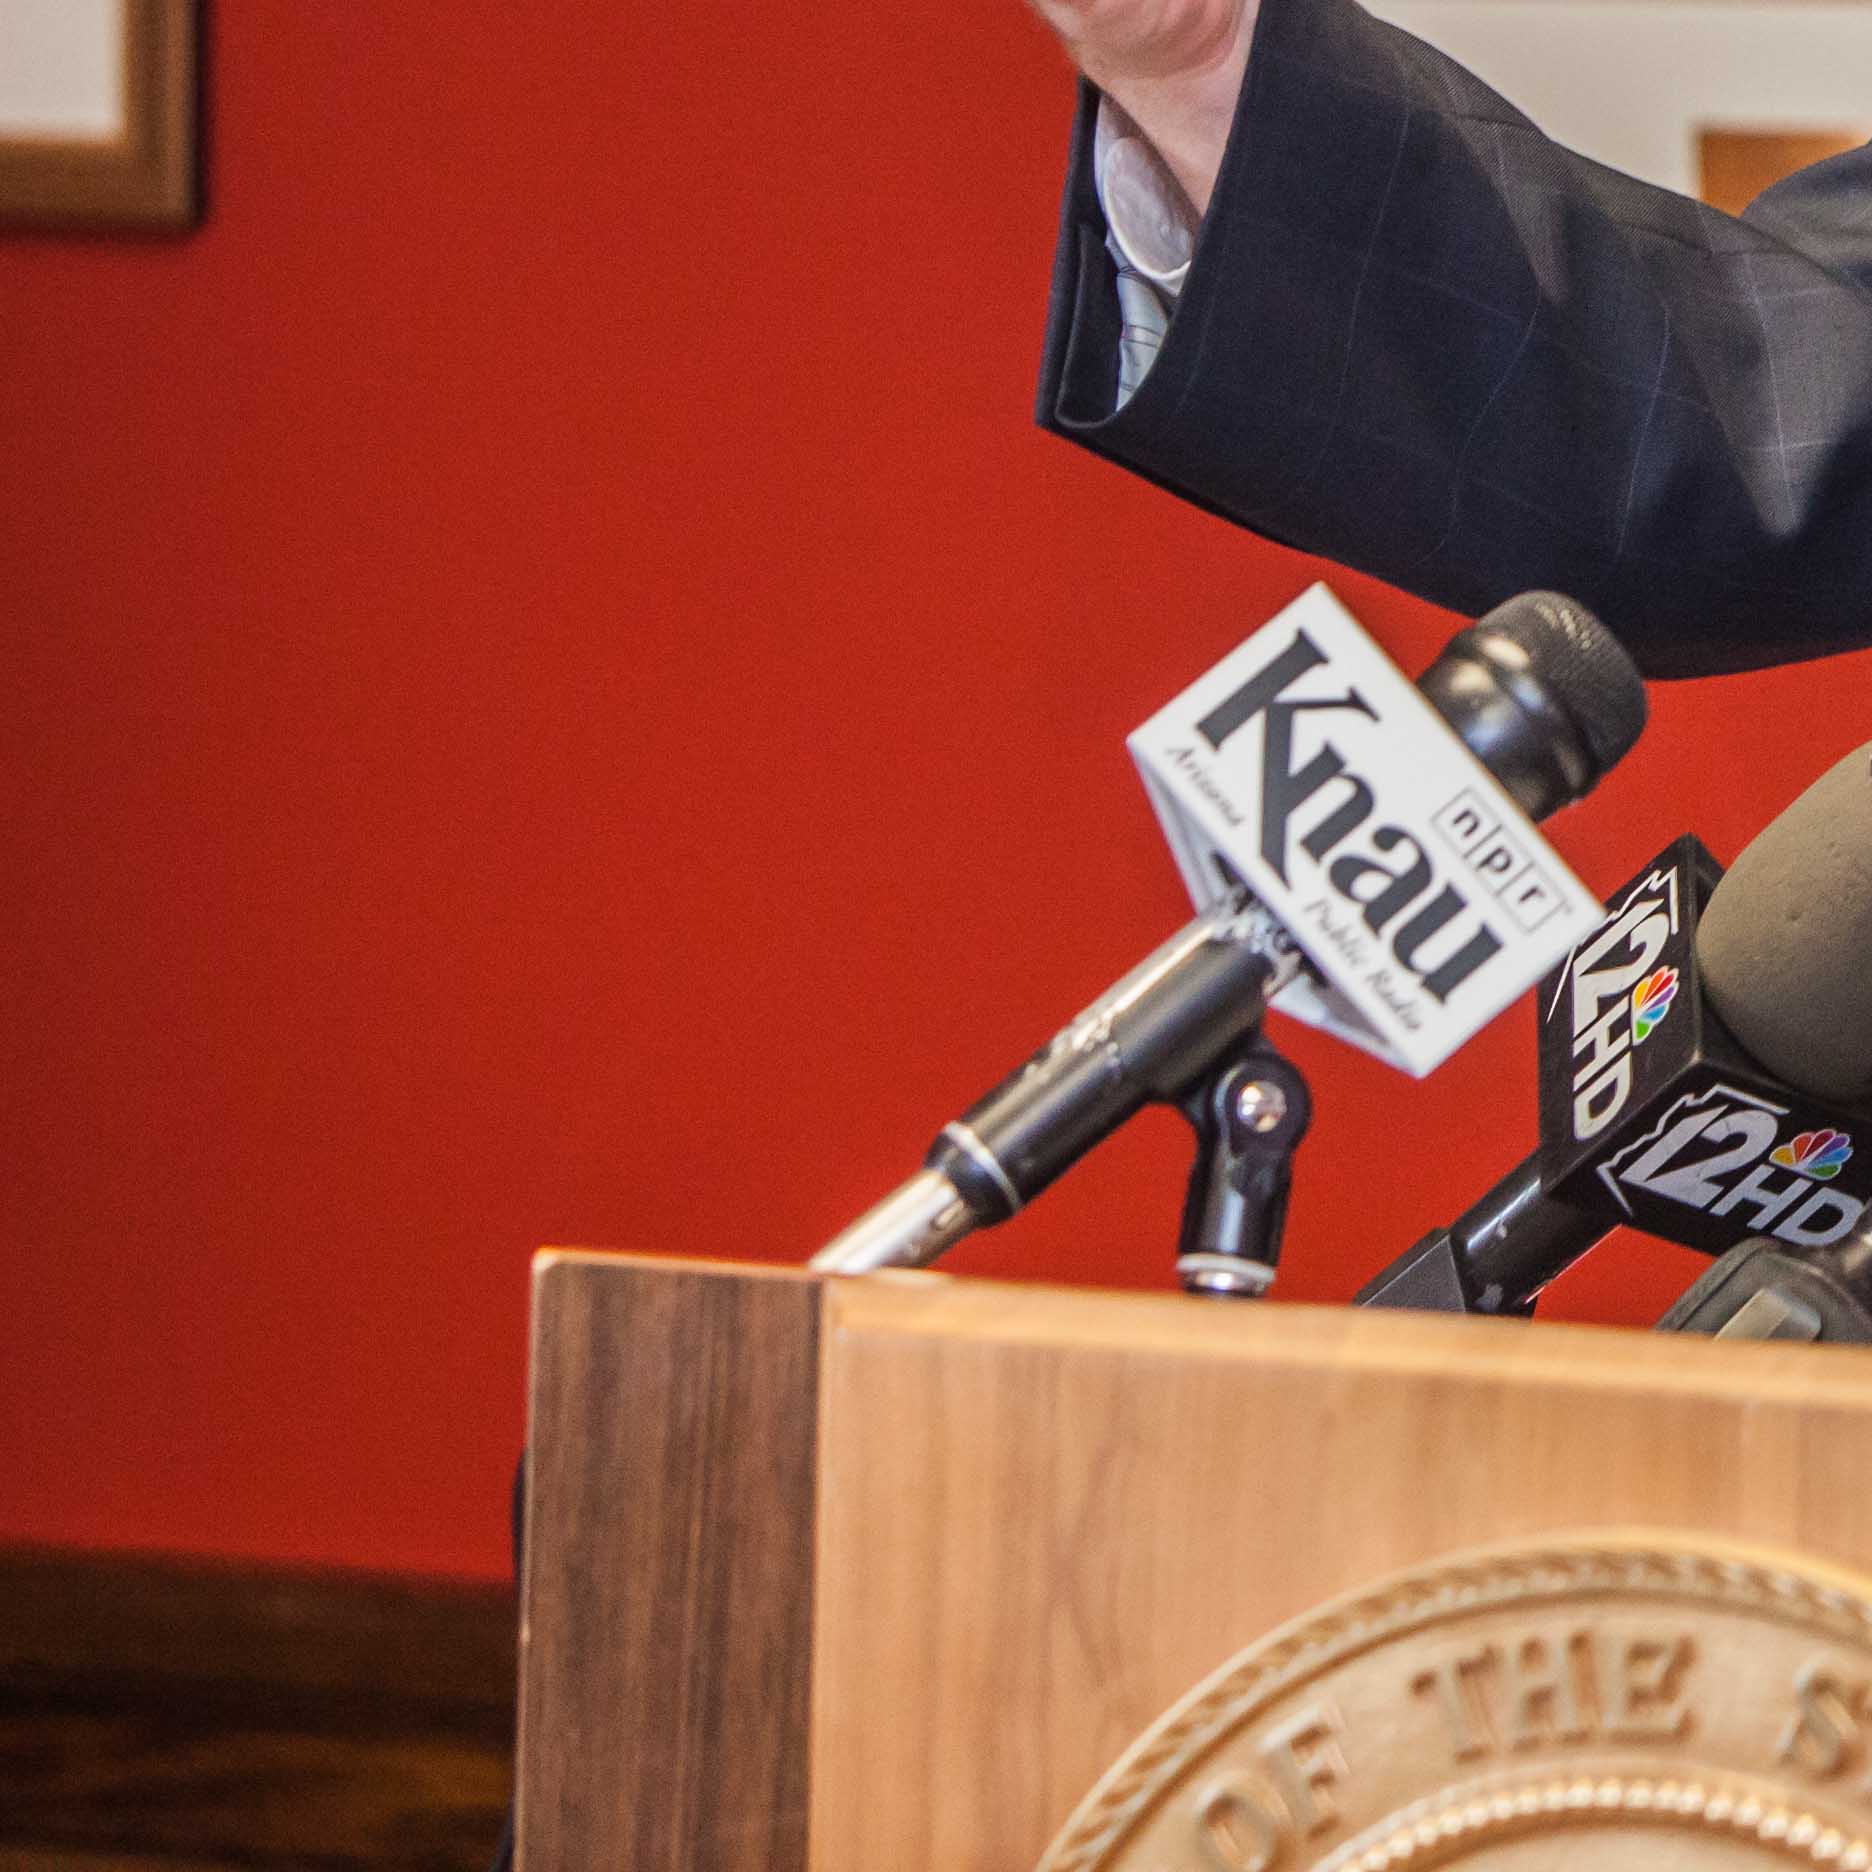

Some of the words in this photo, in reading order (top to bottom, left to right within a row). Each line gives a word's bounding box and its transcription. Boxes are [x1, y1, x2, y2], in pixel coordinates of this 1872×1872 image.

[1195, 626, 1504, 1005] Knau
[1452, 807, 1547, 906] npr
[1408, 1630, 1698, 1762] THE
